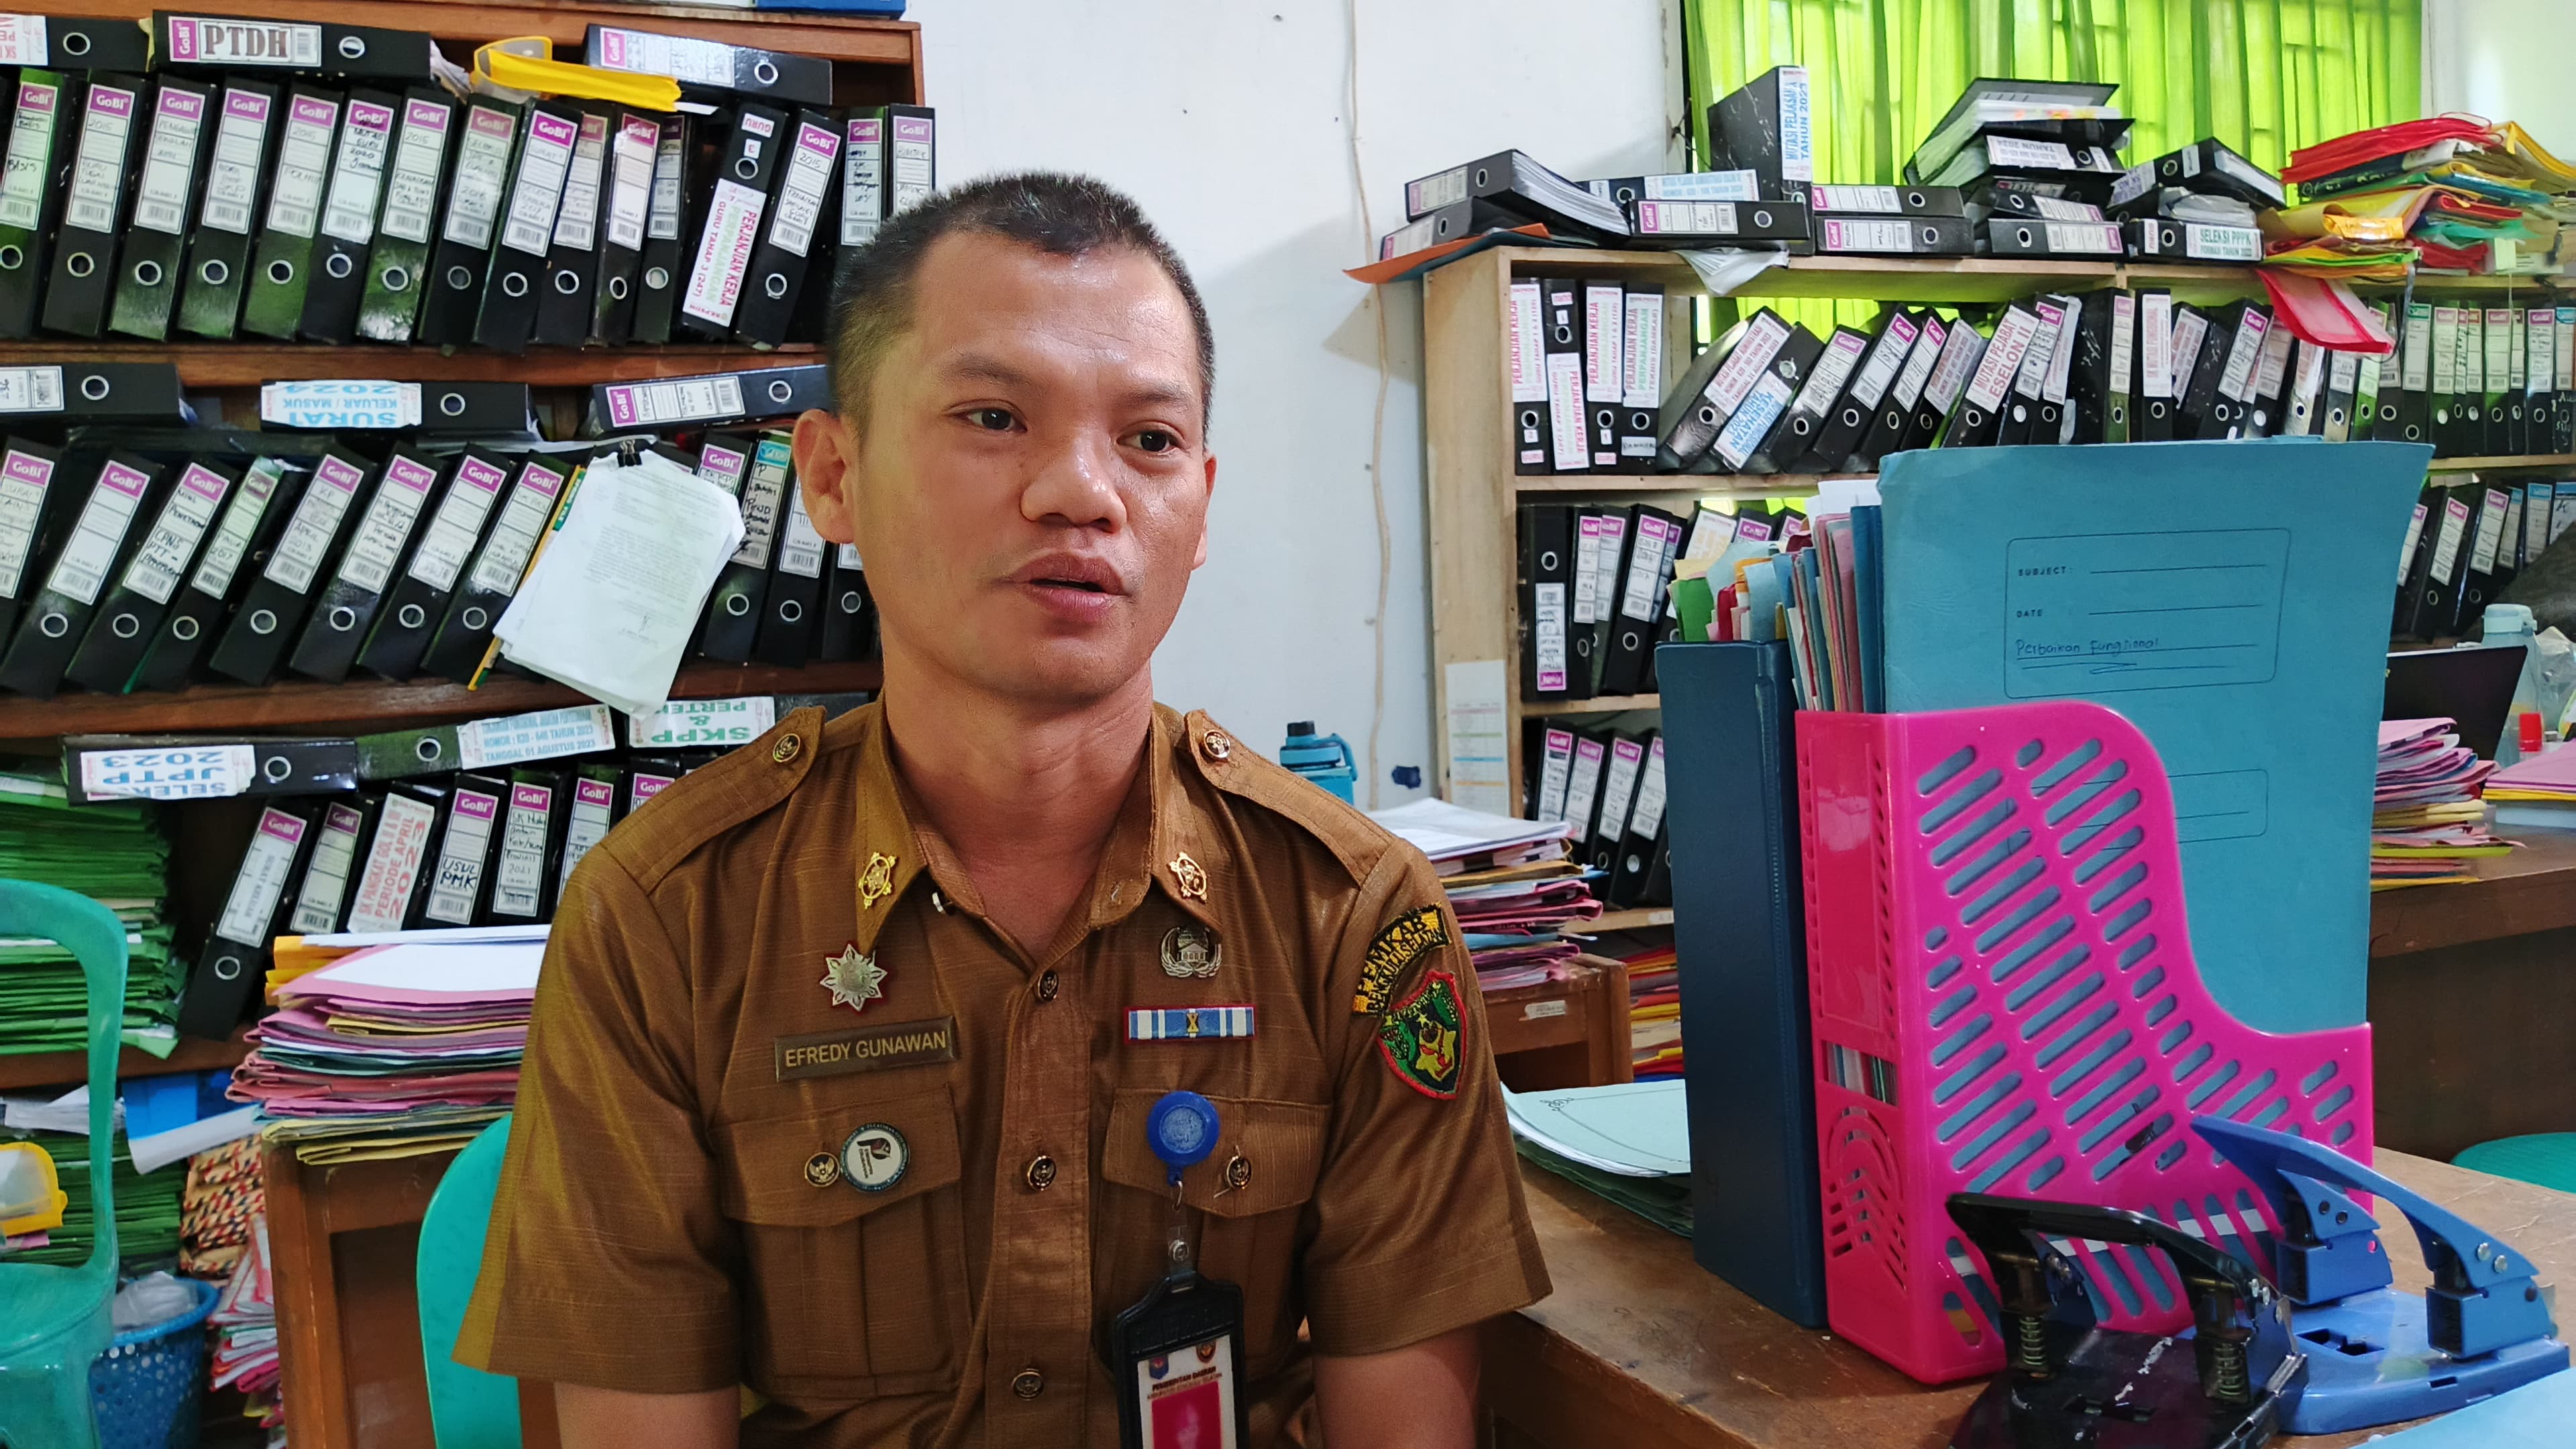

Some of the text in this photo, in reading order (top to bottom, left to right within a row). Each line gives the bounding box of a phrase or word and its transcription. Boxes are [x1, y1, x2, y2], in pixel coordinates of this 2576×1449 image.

[204, 25, 287, 58] PTDH
[539, 121, 567, 139] GoBI
[745, 118, 771, 132] GURU
[1782, 129, 1799, 160] MUTASI
[1799, 117, 1811, 159] TAHUN
[800, 154, 821, 168] 2015
[711, 200, 727, 229] GURU
[2200, 229, 2230, 244] SELEKSI
[702, 231, 718, 262] TAHAP
[704, 205, 743, 303] PERPANJANGAN
[718, 209, 759, 308] PERJANJIAN KERJA
[1509, 299, 1522, 384] PERJANJIAN KERJA
[1588, 302, 1599, 384] PERJANJIAN KERJA
[1625, 307, 1638, 390] PERJANJIAN KERJA
[1637, 308, 1649, 390] PERPANJANGAN
[1974, 317, 2017, 390] MUTASI PEJABAT
[1988, 325, 2032, 398] ESELON II
[284, 383, 398, 394] 2024
[283, 398, 331, 409] MASUK
[343, 398, 396, 409] KELUAR
[1569, 370, 1585, 453] PERJANJIAN KERJA
[1725, 388, 1763, 436] TAHUN 2023
[1728, 388, 1775, 451] KESEHATAN
[709, 454, 734, 467] GoBI
[109, 473, 138, 488] GoBI
[191, 475, 218, 492] GoBI
[327, 467, 352, 483] GoBI
[397, 467, 423, 483] GoBI
[468, 468, 494, 484] GoBI
[529, 473, 553, 489] GoBI
[2018, 566, 2067, 577] SUBJECT
[2017, 609, 2043, 618] DATE
[2016, 639, 2080, 655] Perbaikan
[688, 715, 710, 727] &
[651, 727, 750, 743] SKPP
[484, 748, 523, 762] TANGGAL
[537, 741, 575, 755] AGUSTUS
[577, 738, 595, 749] 2023
[102, 751, 223, 767] 2023
[103, 767, 225, 785] JPTP
[519, 792, 542, 804] GoBI
[582, 788, 605, 799] GoBI
[462, 799, 488, 812] GoBI
[269, 818, 299, 834] GoBI
[372, 814, 415, 918] PERIODE APRIL
[385, 819, 429, 921] 2023
[443, 858, 475, 874] USUL
[360, 858, 386, 901] PANGKAT
[439, 871, 478, 889] PMK
[356, 902, 373, 916] SK
[786, 1030, 947, 1068] EFREDY GUNAWAN
